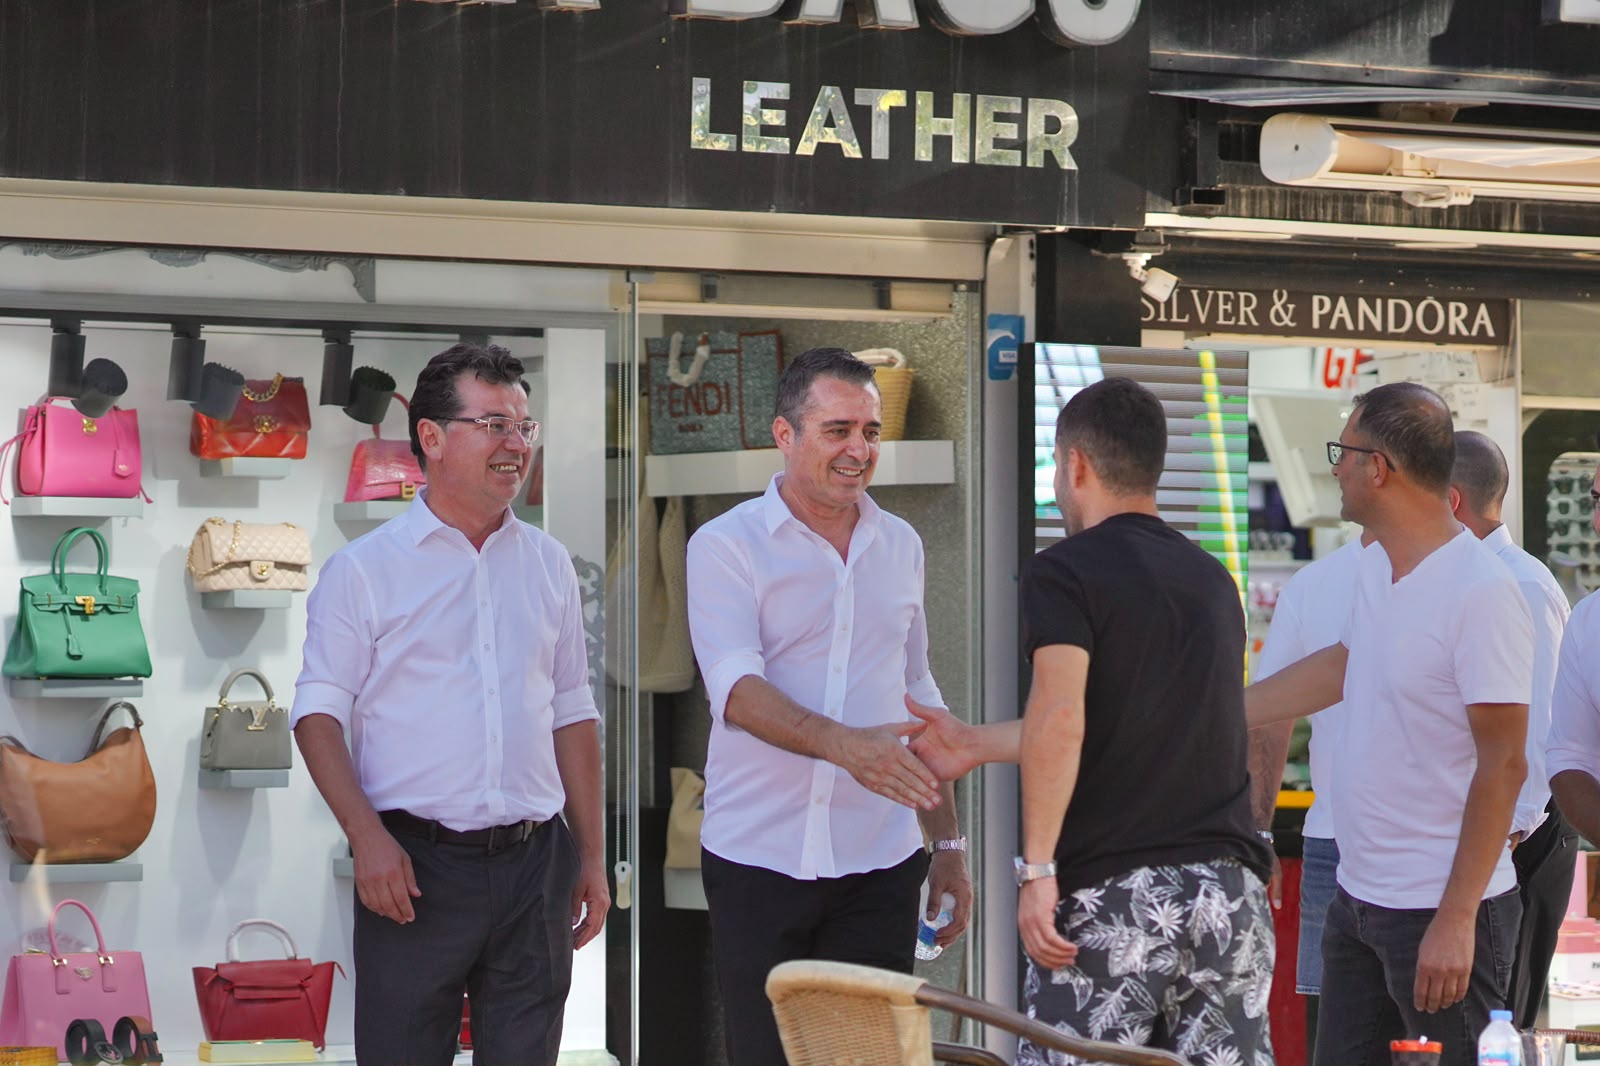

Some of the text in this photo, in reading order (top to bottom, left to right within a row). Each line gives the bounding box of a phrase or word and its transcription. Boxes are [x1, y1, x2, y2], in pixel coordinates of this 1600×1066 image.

[691, 77, 1079, 170] LEATHER
[1269, 288, 1297, 327] &
[1311, 294, 1496, 337] PANDORA
[656, 381, 731, 418] FENDI
